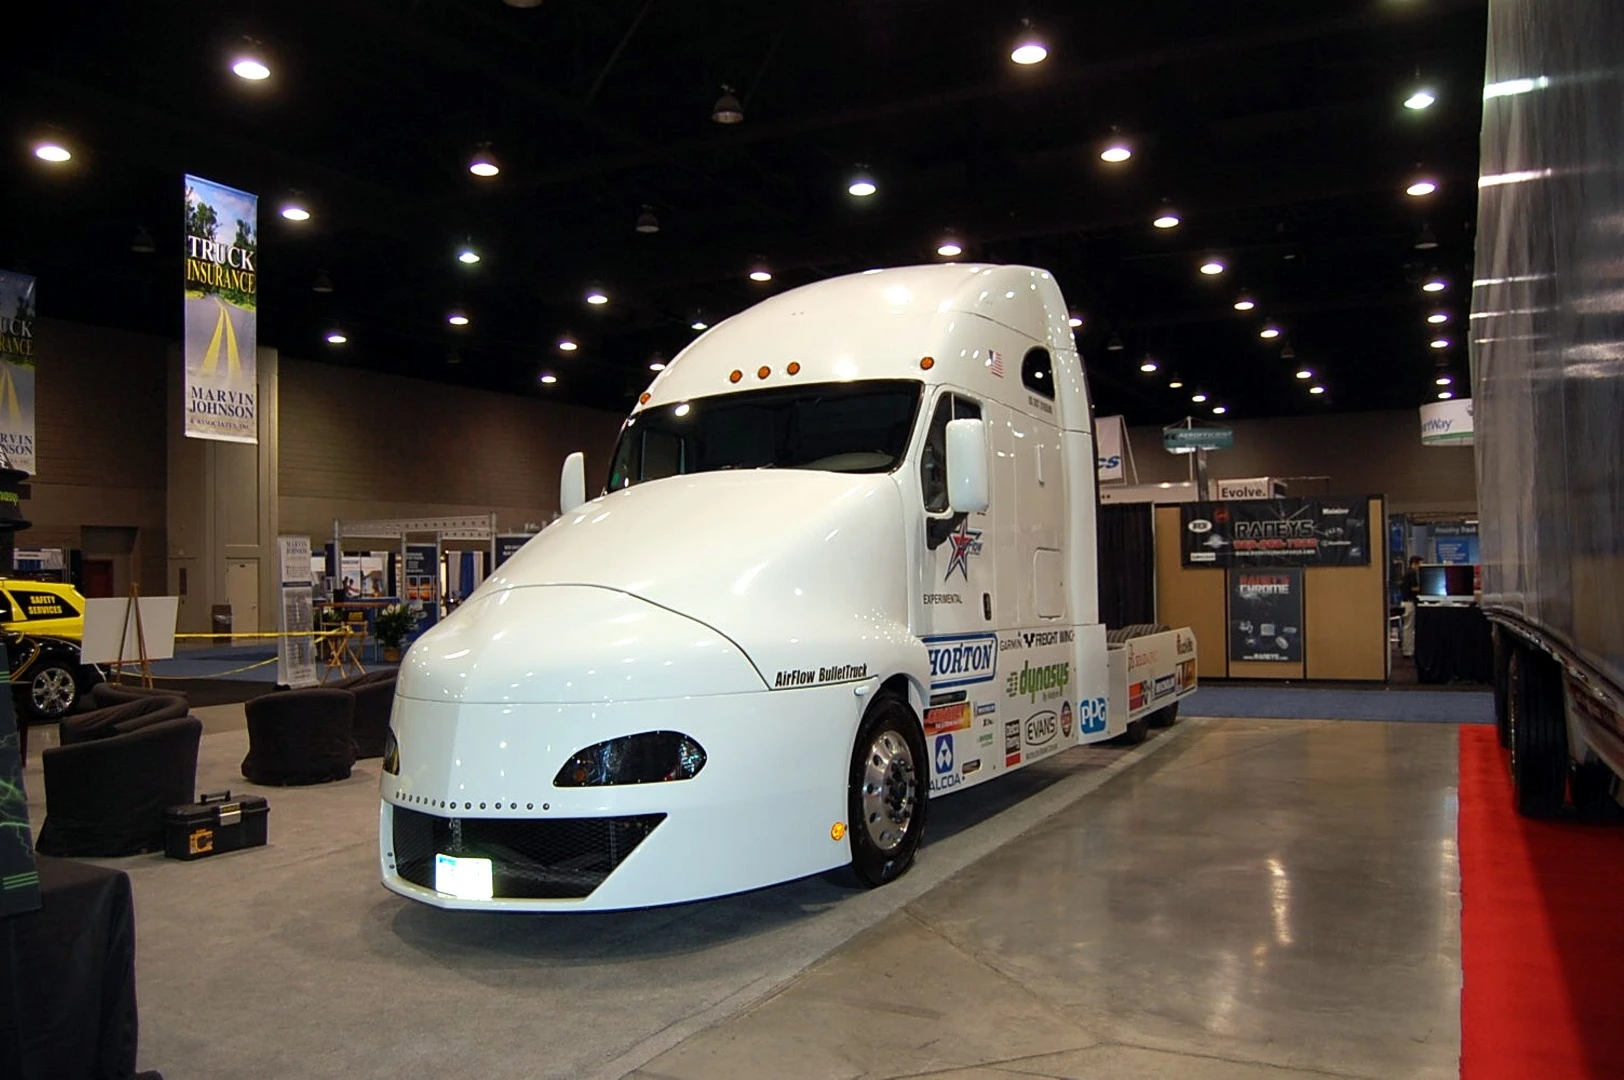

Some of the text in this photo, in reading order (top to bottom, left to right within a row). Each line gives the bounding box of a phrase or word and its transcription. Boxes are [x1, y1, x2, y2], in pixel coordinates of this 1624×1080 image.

[187, 235, 254, 271] TRUCK
[187, 259, 255, 294] INSURANCE
[191, 386, 254, 405] MARVIN
[189, 400, 254, 419] JOHNSON
[1221, 486, 1267, 499] Evolve.
[1239, 585, 1290, 594] CHROME
[30, 595, 56, 604] SAFETY
[923, 594, 963, 605] EXPERIMENTAL
[28, 606, 63, 615] SERVICES
[928, 644, 992, 676] HORTON
[775, 663, 867, 687] AirFlow BulletTruck
[1020, 660, 1069, 704] dynasys
[1081, 700, 1106, 728] PPG
[1028, 716, 1056, 741] EVANS
[930, 774, 961, 791] ALCOA
